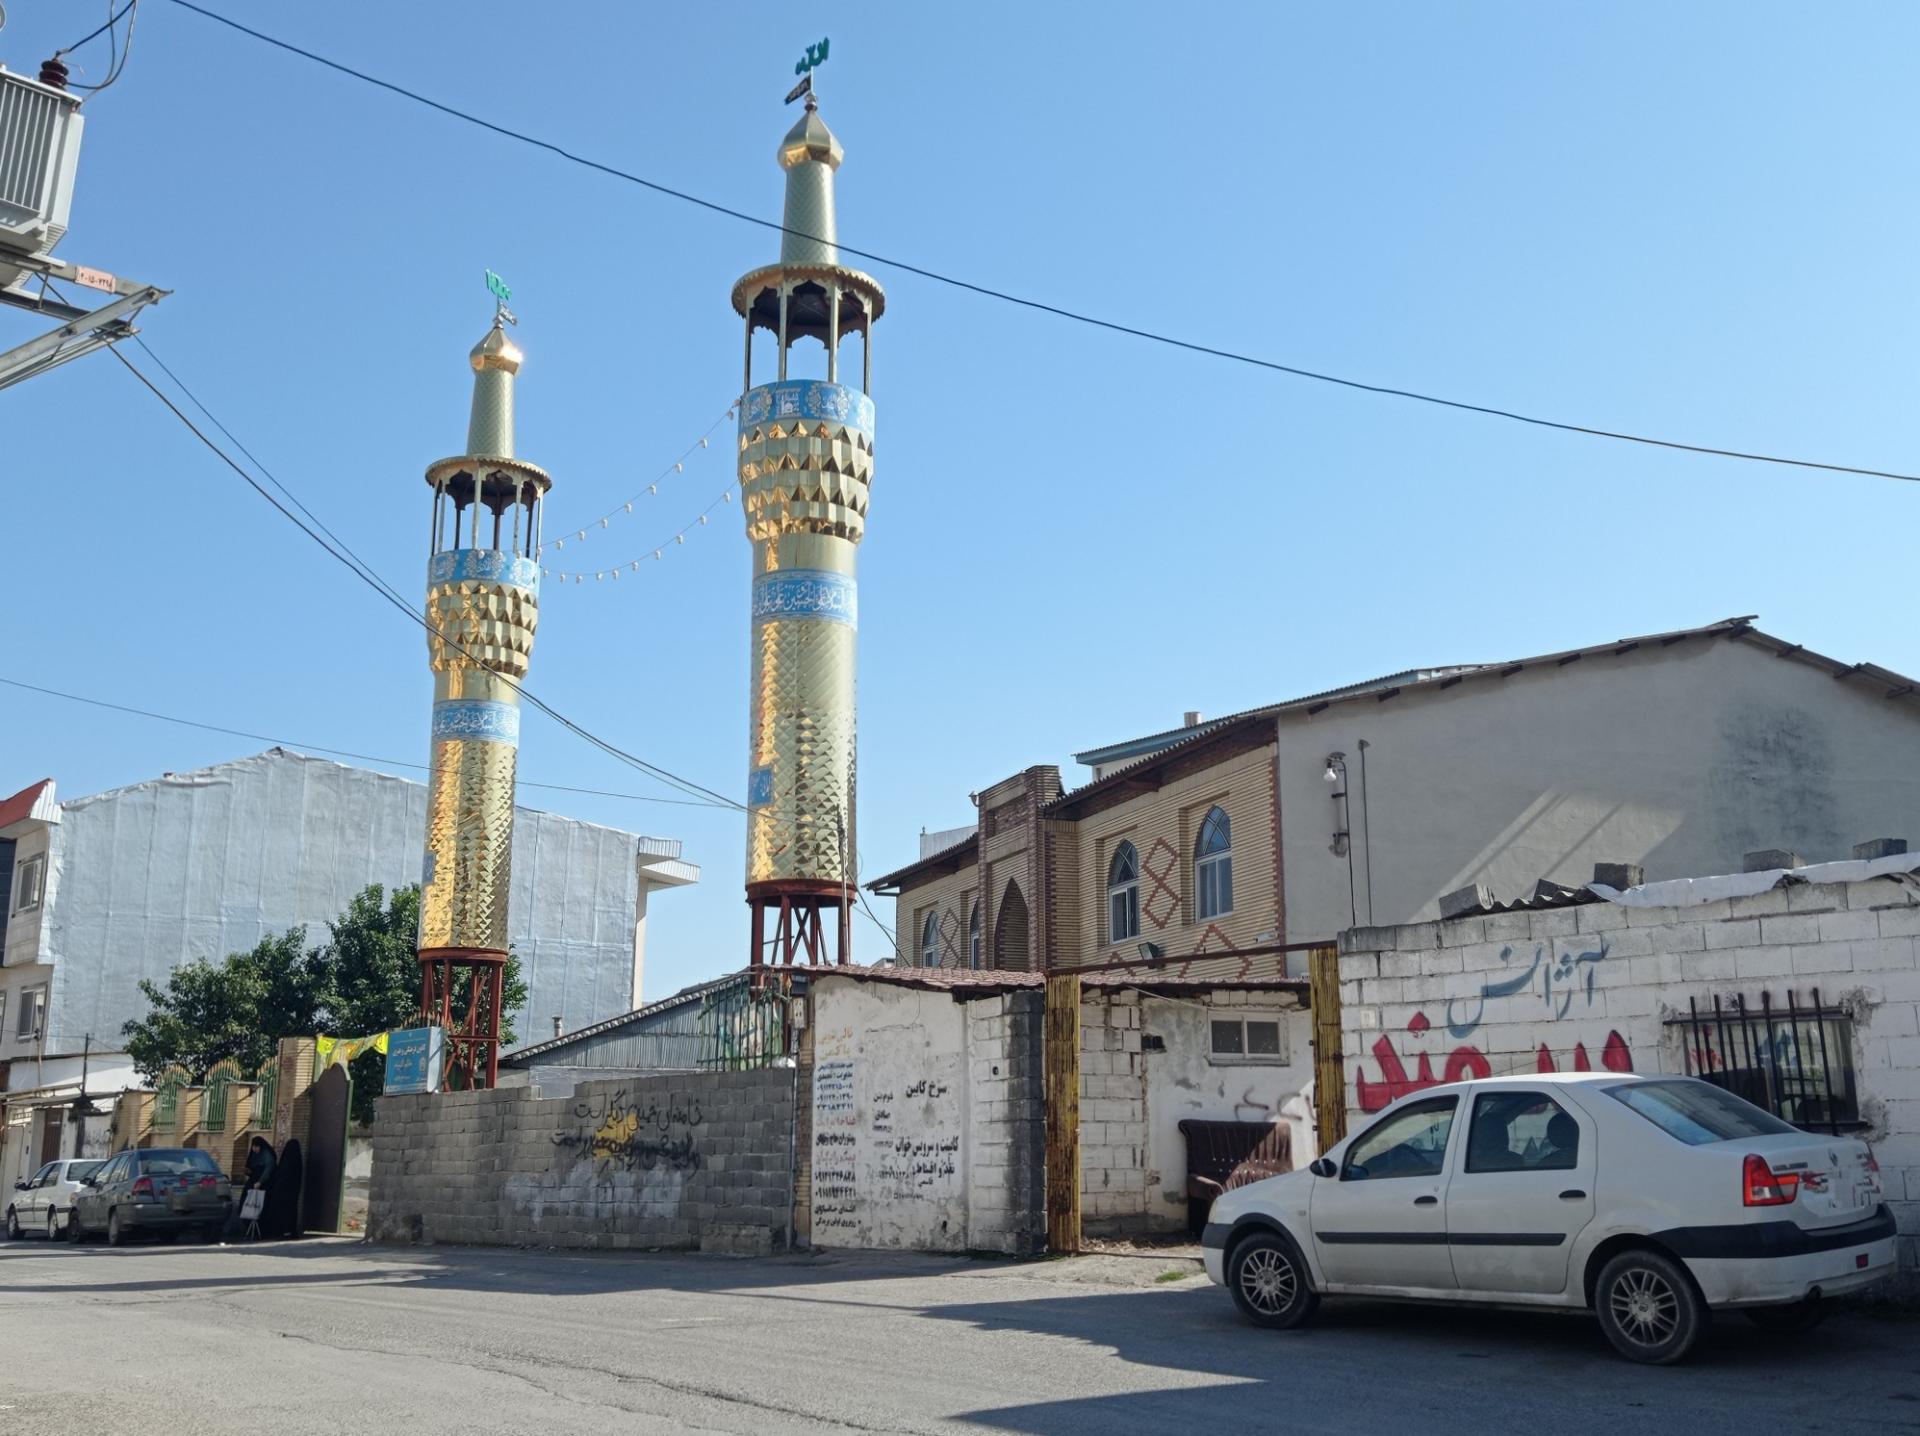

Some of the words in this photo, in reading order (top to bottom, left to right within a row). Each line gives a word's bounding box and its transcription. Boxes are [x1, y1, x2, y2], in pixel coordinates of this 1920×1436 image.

[895, 1136, 912, 1158] خواب
[912, 1141, 935, 1158] سرویس
[940, 1136, 959, 1156] کابینت
